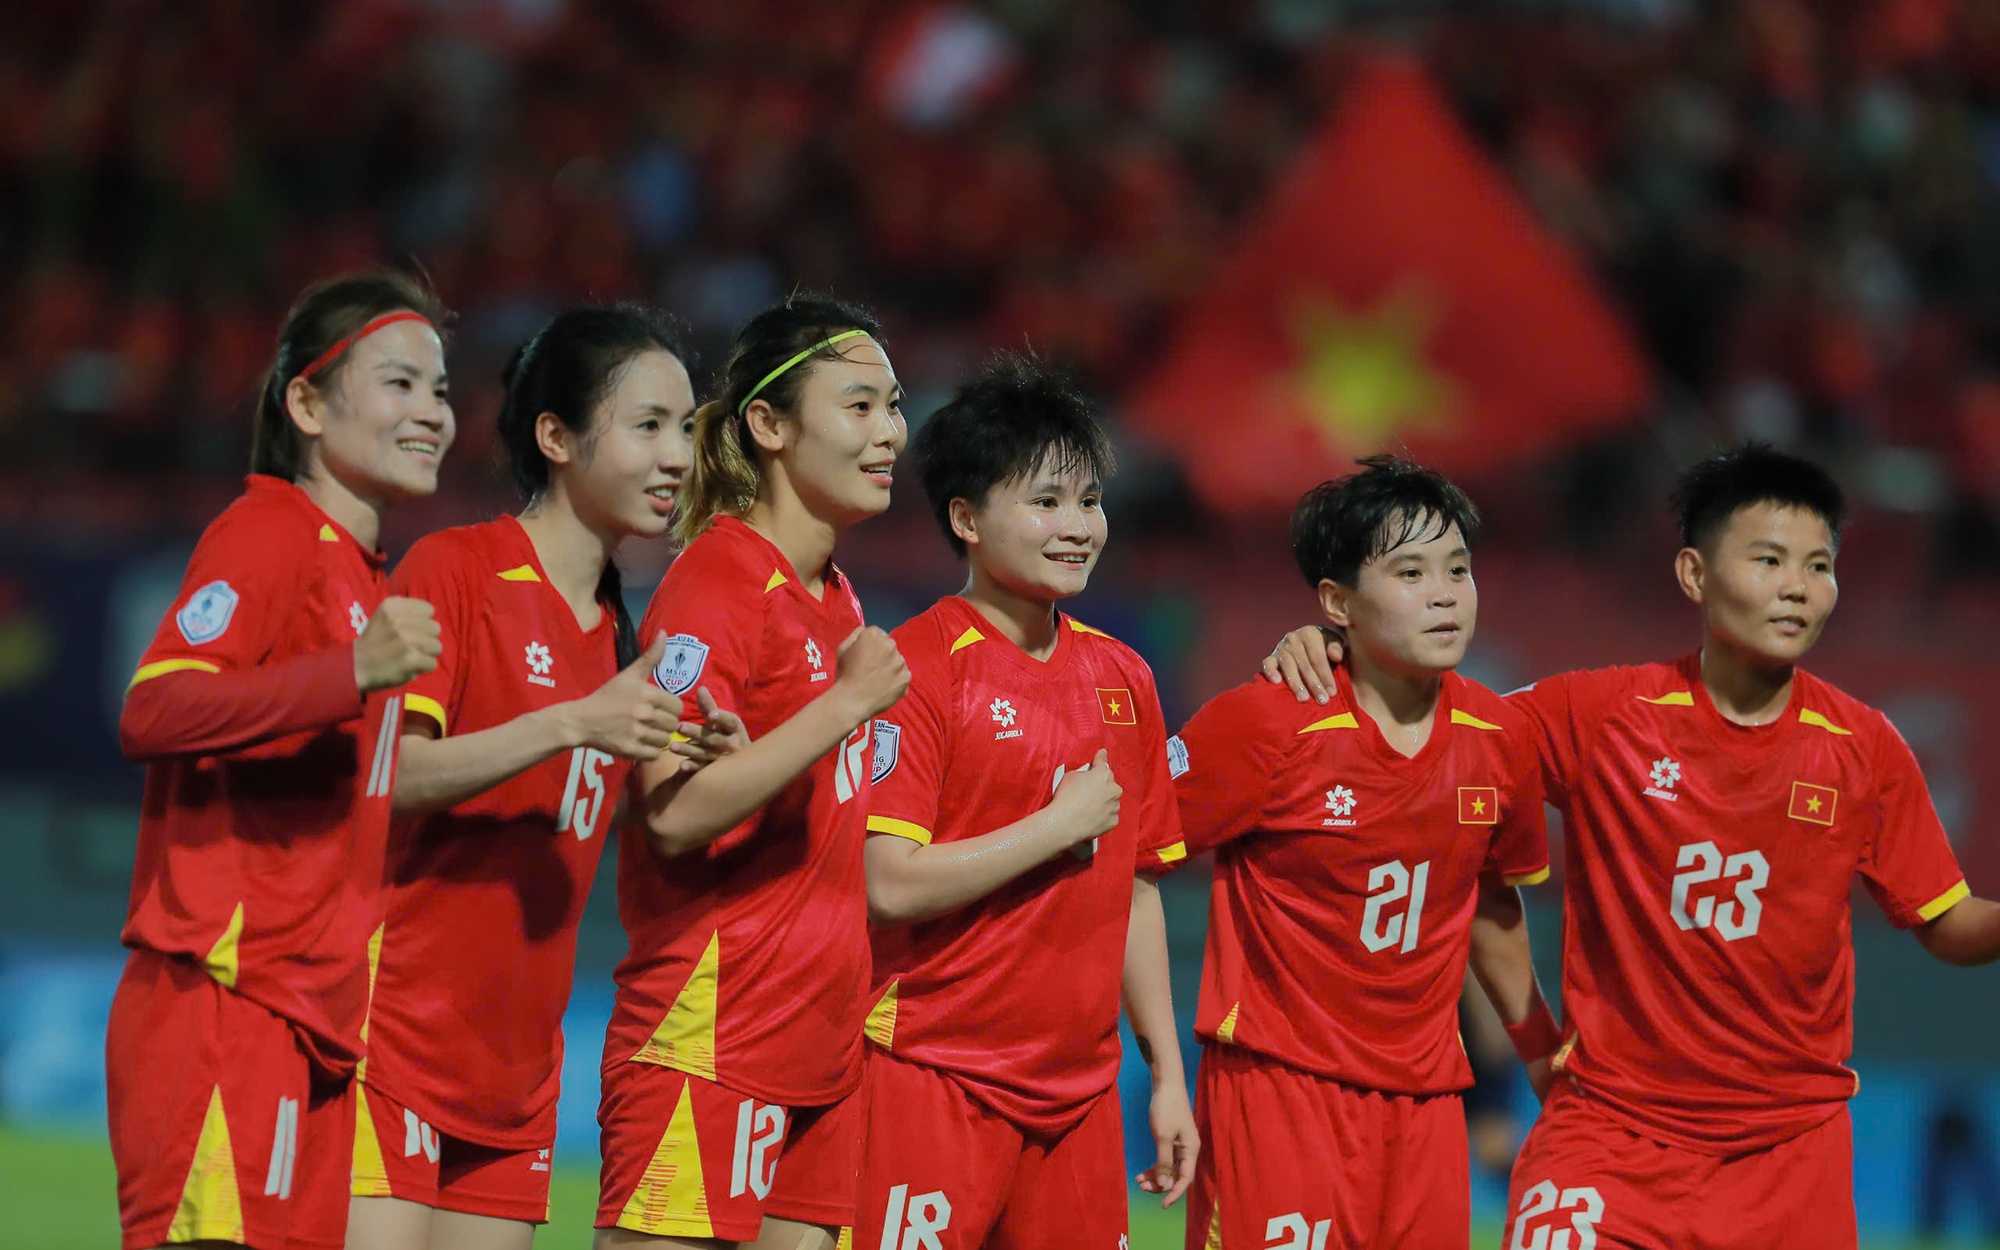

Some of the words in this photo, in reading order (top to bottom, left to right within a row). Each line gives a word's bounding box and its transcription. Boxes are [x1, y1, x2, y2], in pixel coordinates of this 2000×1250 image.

[665, 678, 683, 686] CUP
[666, 668, 687, 676] MSIG
[366, 697, 400, 797] 11
[558, 747, 615, 841] 15
[1360, 859, 1430, 954] 21
[1670, 840, 1770, 942] 23
[264, 1096, 298, 1200] 11
[730, 1098, 786, 1201] 12
[879, 1183, 952, 1250] 18
[1510, 1179, 1605, 1250] 23
